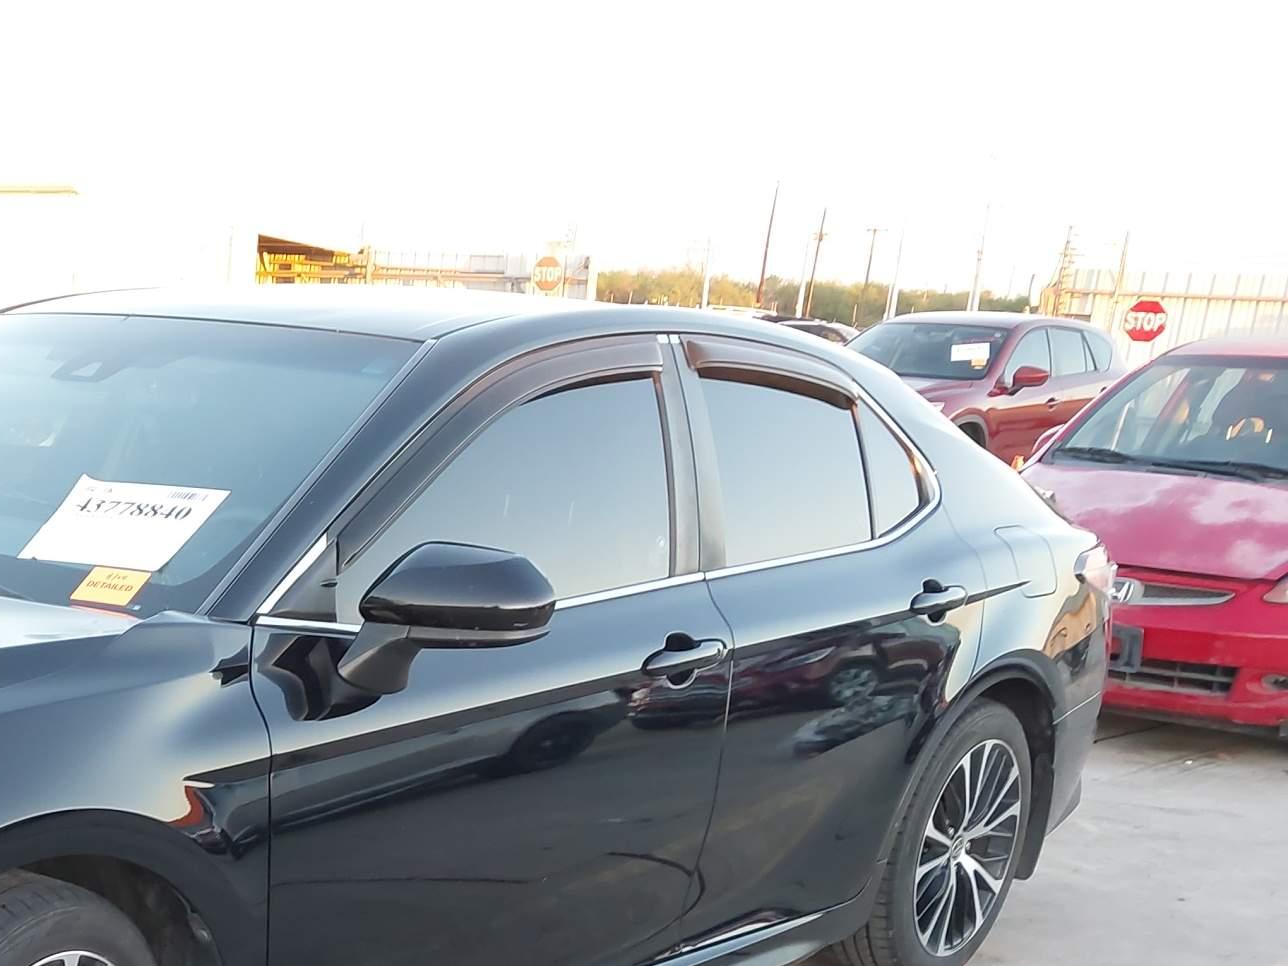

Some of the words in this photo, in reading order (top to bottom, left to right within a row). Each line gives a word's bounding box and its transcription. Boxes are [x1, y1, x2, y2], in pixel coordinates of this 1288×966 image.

[534, 266, 562, 283] STOP
[1124, 311, 1167, 332] STOP
[76, 497, 193, 521] 43778840
[86, 579, 134, 592] DETAILED
